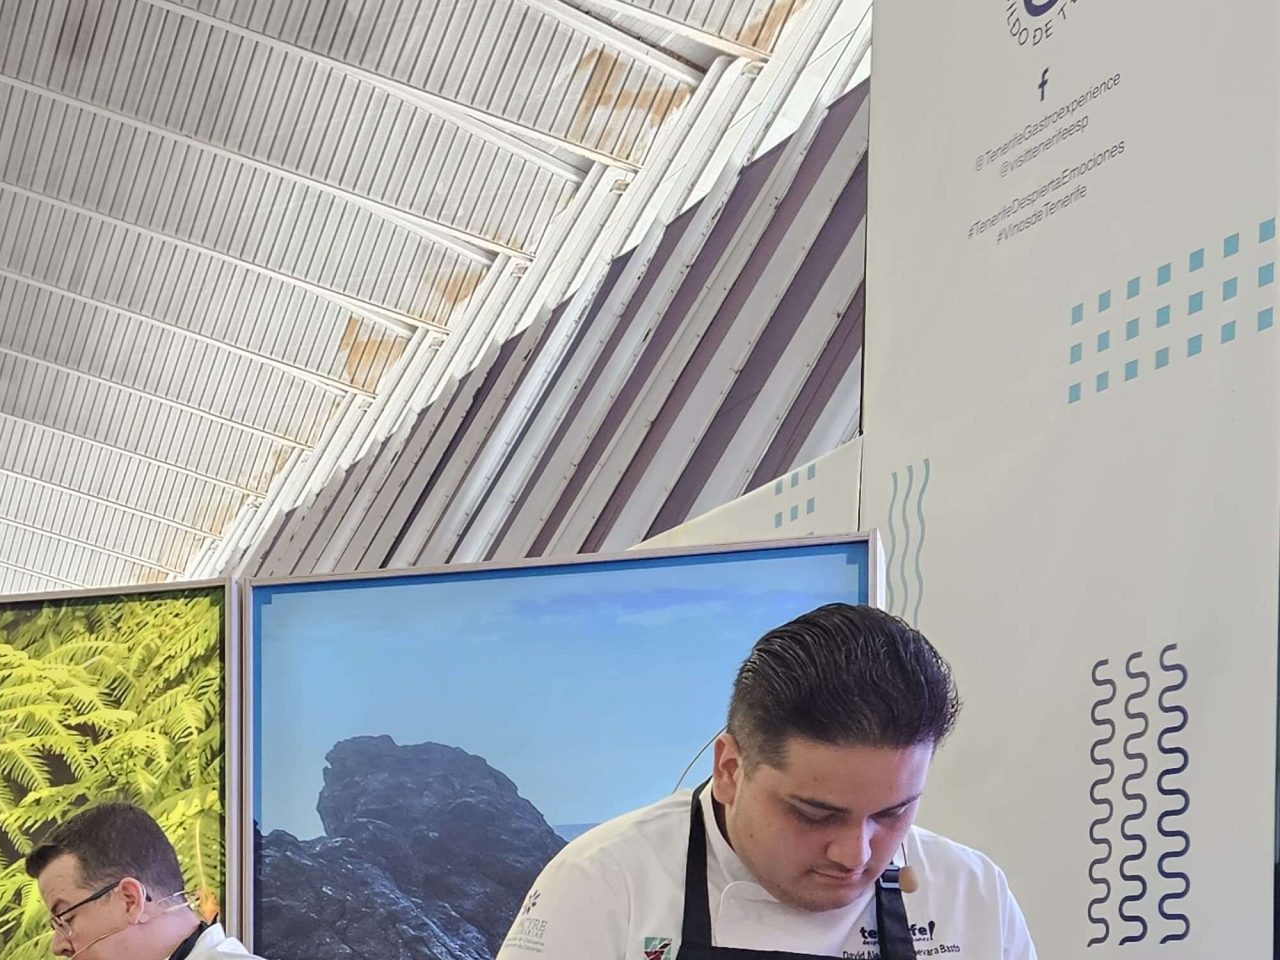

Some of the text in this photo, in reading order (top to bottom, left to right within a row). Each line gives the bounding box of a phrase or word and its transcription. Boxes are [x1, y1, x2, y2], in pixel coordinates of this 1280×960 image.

[1032, 20, 1054, 46] DE
[975, 72, 1121, 172] @TenerifeGastroexperience
[967, 140, 1126, 241] #TenerifeDespiertaEmociones
